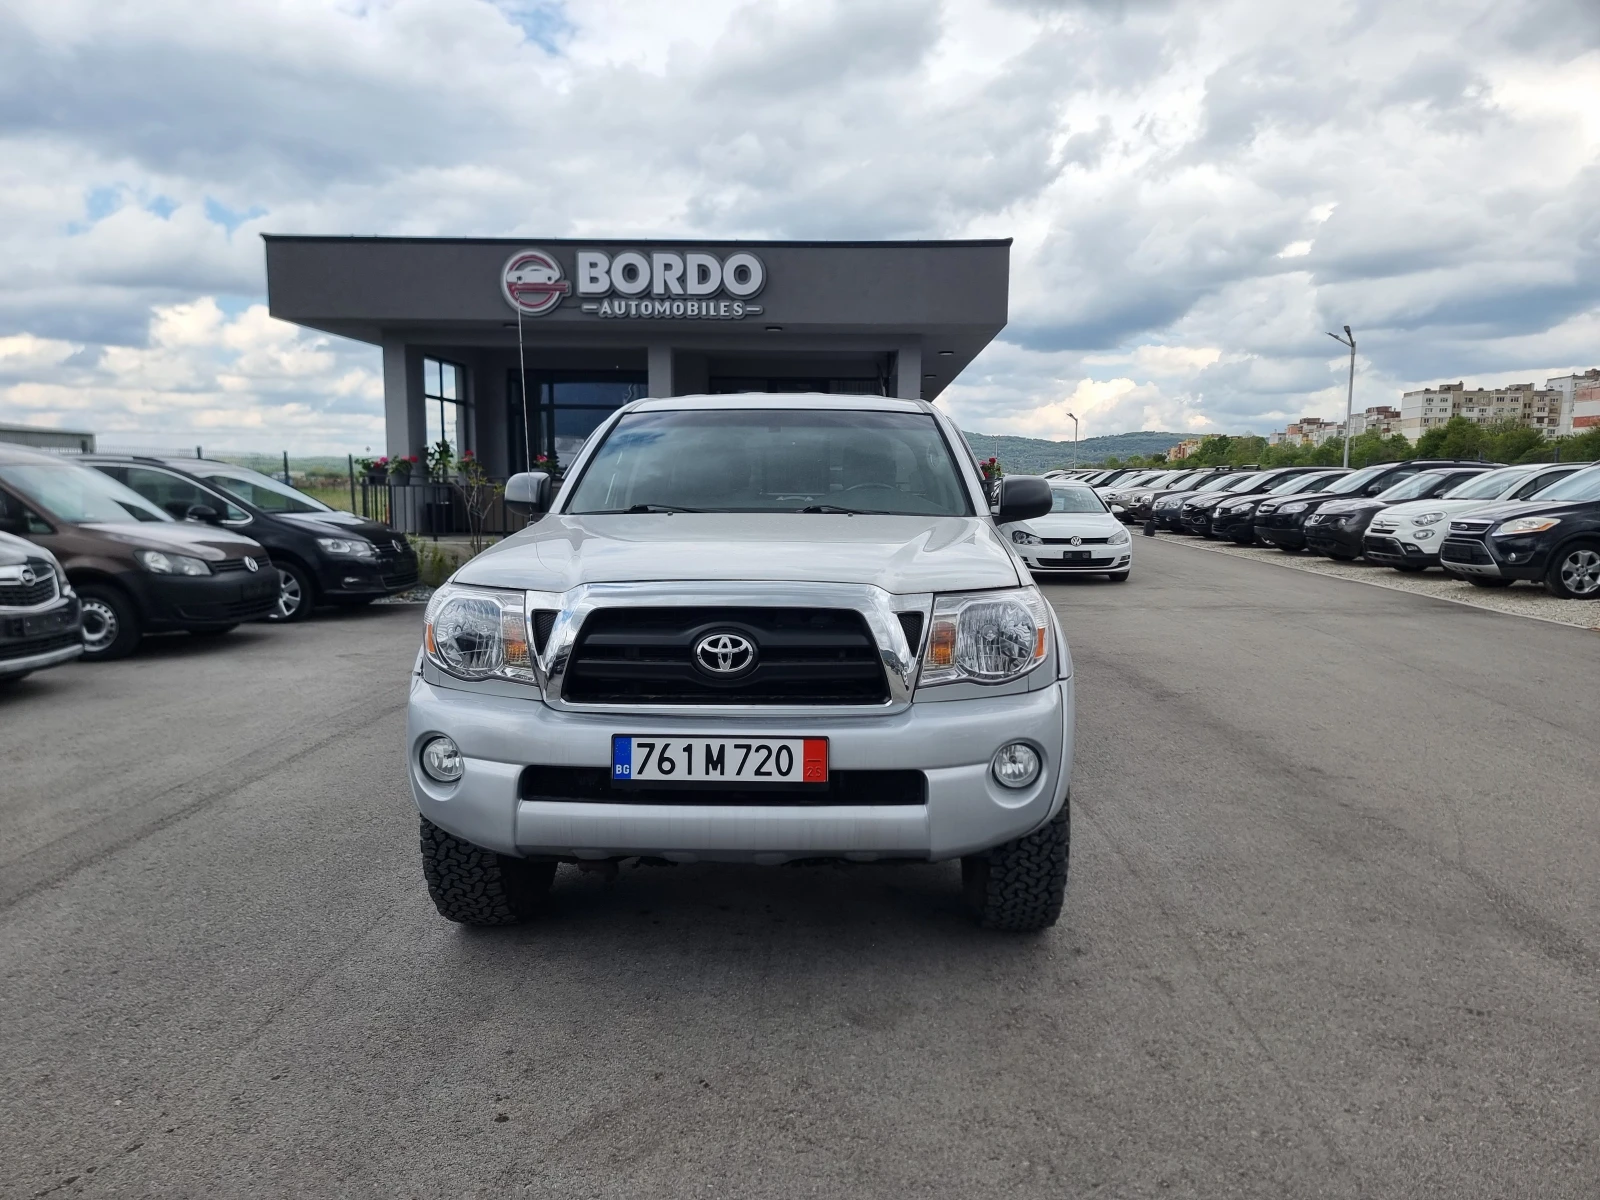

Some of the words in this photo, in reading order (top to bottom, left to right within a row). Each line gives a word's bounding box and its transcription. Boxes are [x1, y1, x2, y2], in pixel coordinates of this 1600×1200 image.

[577, 251, 763, 296] BORDO
[600, 301, 743, 316] AUTOMOBILES
[615, 764, 630, 775] BG
